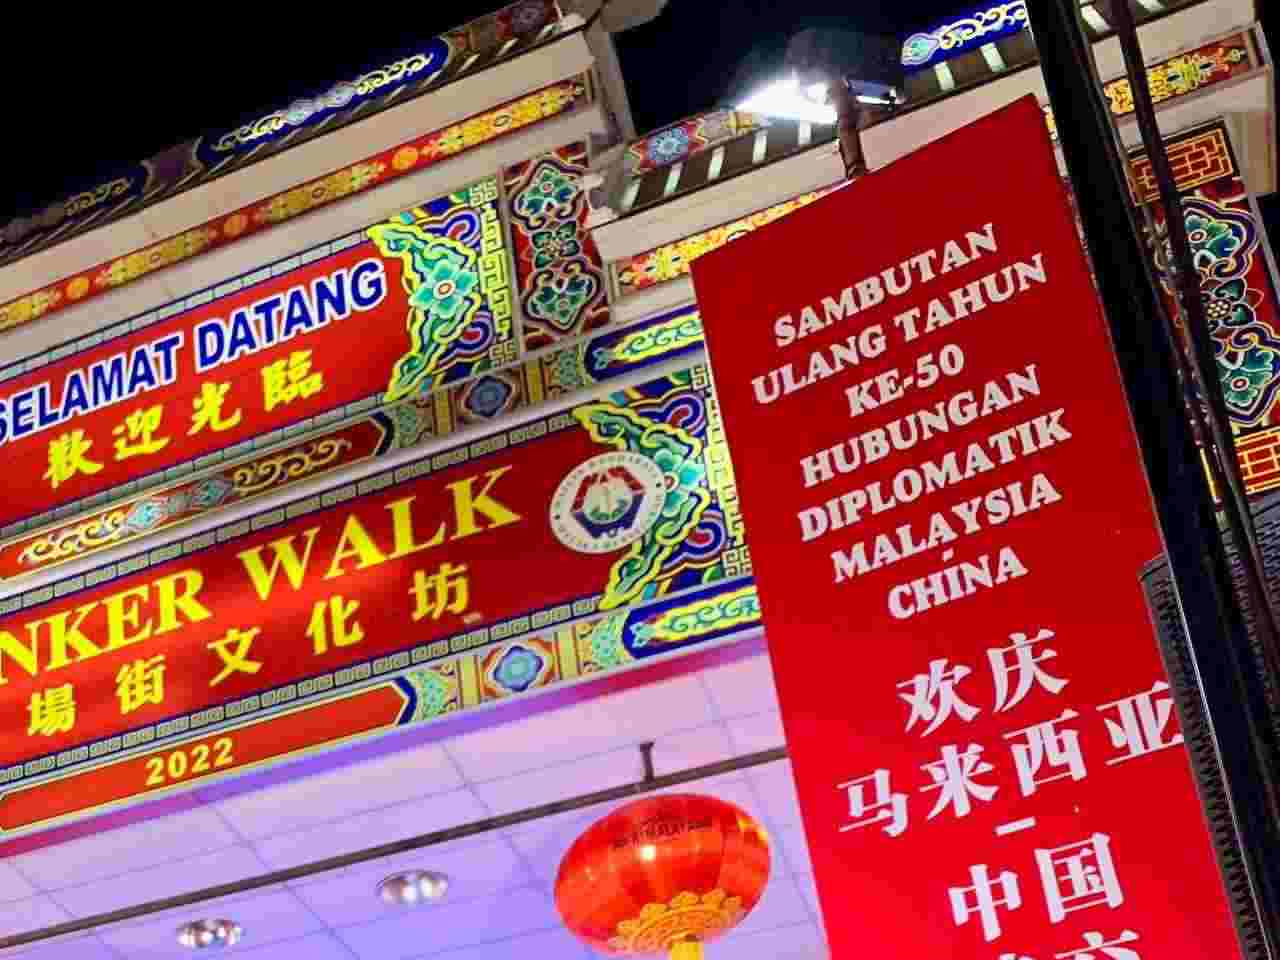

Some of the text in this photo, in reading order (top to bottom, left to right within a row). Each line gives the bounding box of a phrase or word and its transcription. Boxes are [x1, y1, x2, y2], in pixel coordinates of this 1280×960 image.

[193, 259, 388, 373] DATANG
[751, 254, 1048, 405] ULANG TAHUN
[774, 223, 1000, 347] SAMBUTAN
[799, 364, 1041, 488] HUBUNGAN
[844, 344, 966, 418] KE-50
[797, 407, 1073, 542] DIPLOMATIK
[831, 473, 1062, 584] MALAYSIA
[236, 464, 524, 602] WALK
[888, 545, 1029, 621] CHINA
[896, 628, 1070, 738] 欢庆
[145, 737, 233, 786] 2022
[837, 680, 1184, 838] 马来西亚
[948, 832, 1124, 942] 中国
